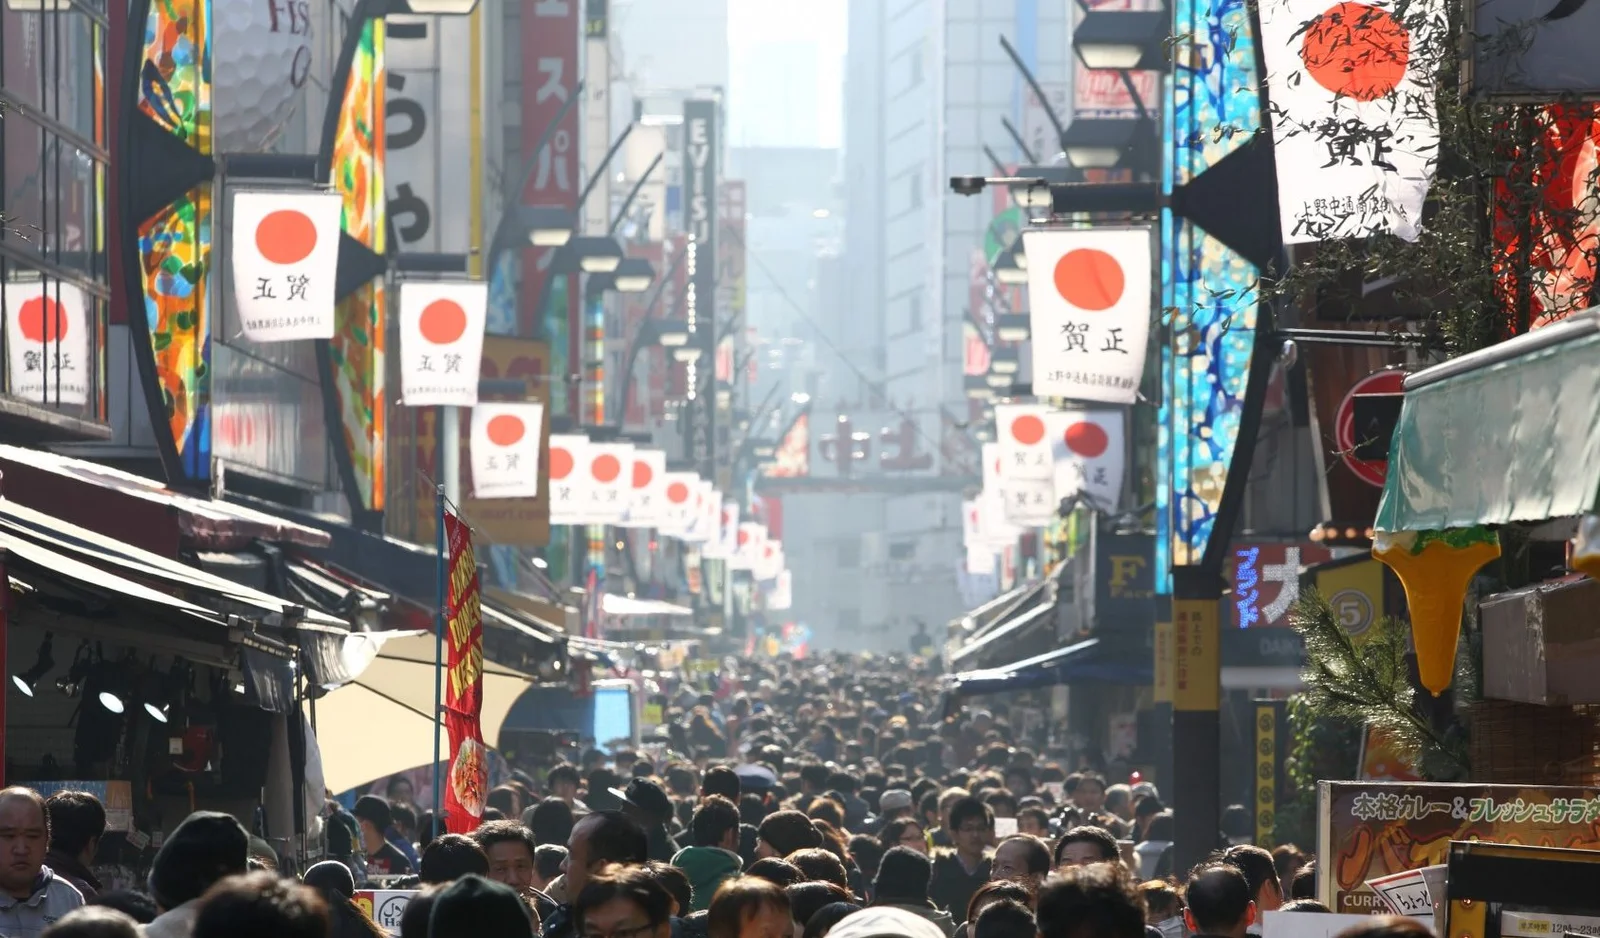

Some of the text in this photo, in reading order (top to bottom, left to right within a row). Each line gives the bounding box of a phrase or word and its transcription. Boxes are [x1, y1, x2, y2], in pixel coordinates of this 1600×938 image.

[386, 22, 430, 252] らや
[1060, 321, 1128, 355] 賀正
[1236, 546, 1259, 629] ブランド
